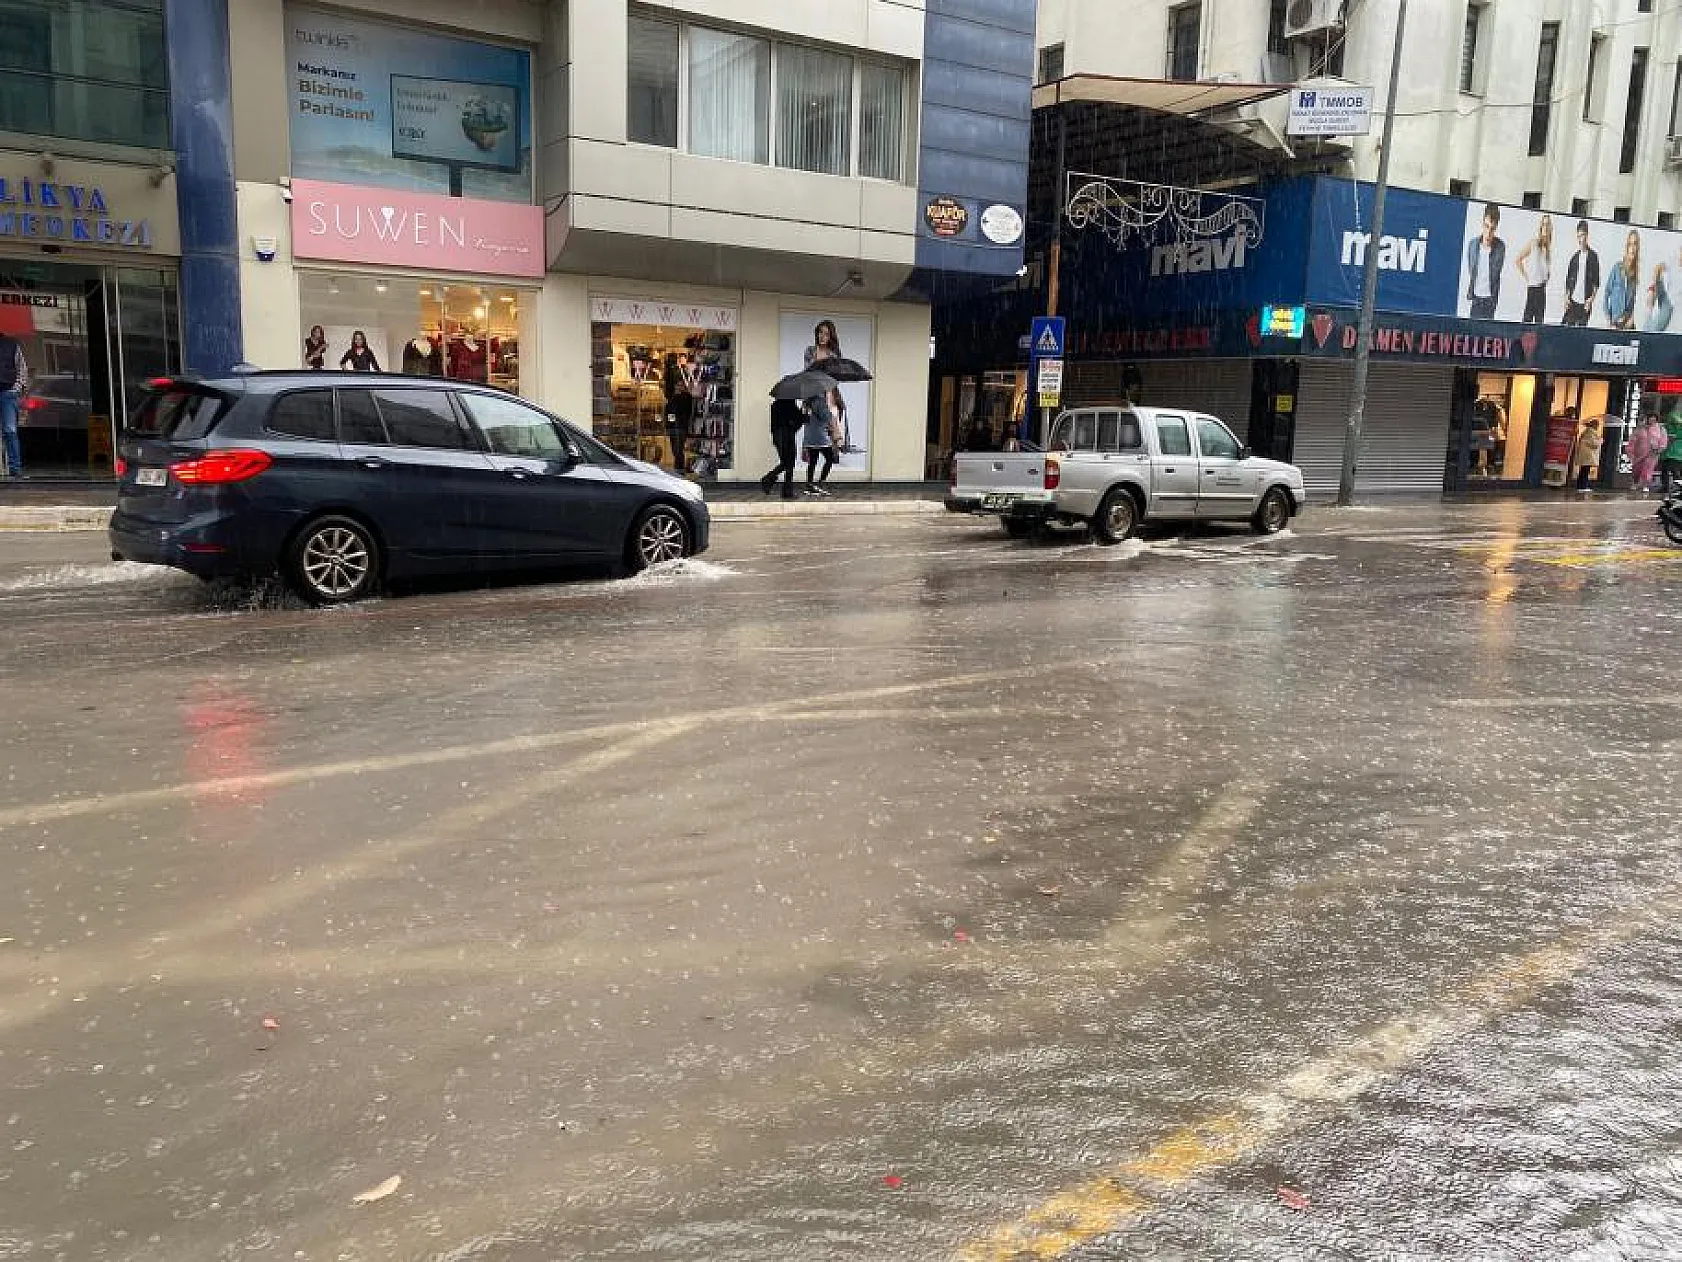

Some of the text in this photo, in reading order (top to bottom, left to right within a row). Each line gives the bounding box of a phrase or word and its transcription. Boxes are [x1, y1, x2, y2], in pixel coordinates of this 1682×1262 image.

[1319, 97, 1363, 108] TMMOB
[309, 201, 466, 248] SUWEN
[1151, 221, 1247, 276] mavi
[1340, 228, 1429, 273] mavi
[1419, 331, 1512, 360] JEWELLERY
[1592, 340, 1641, 365] mavi
